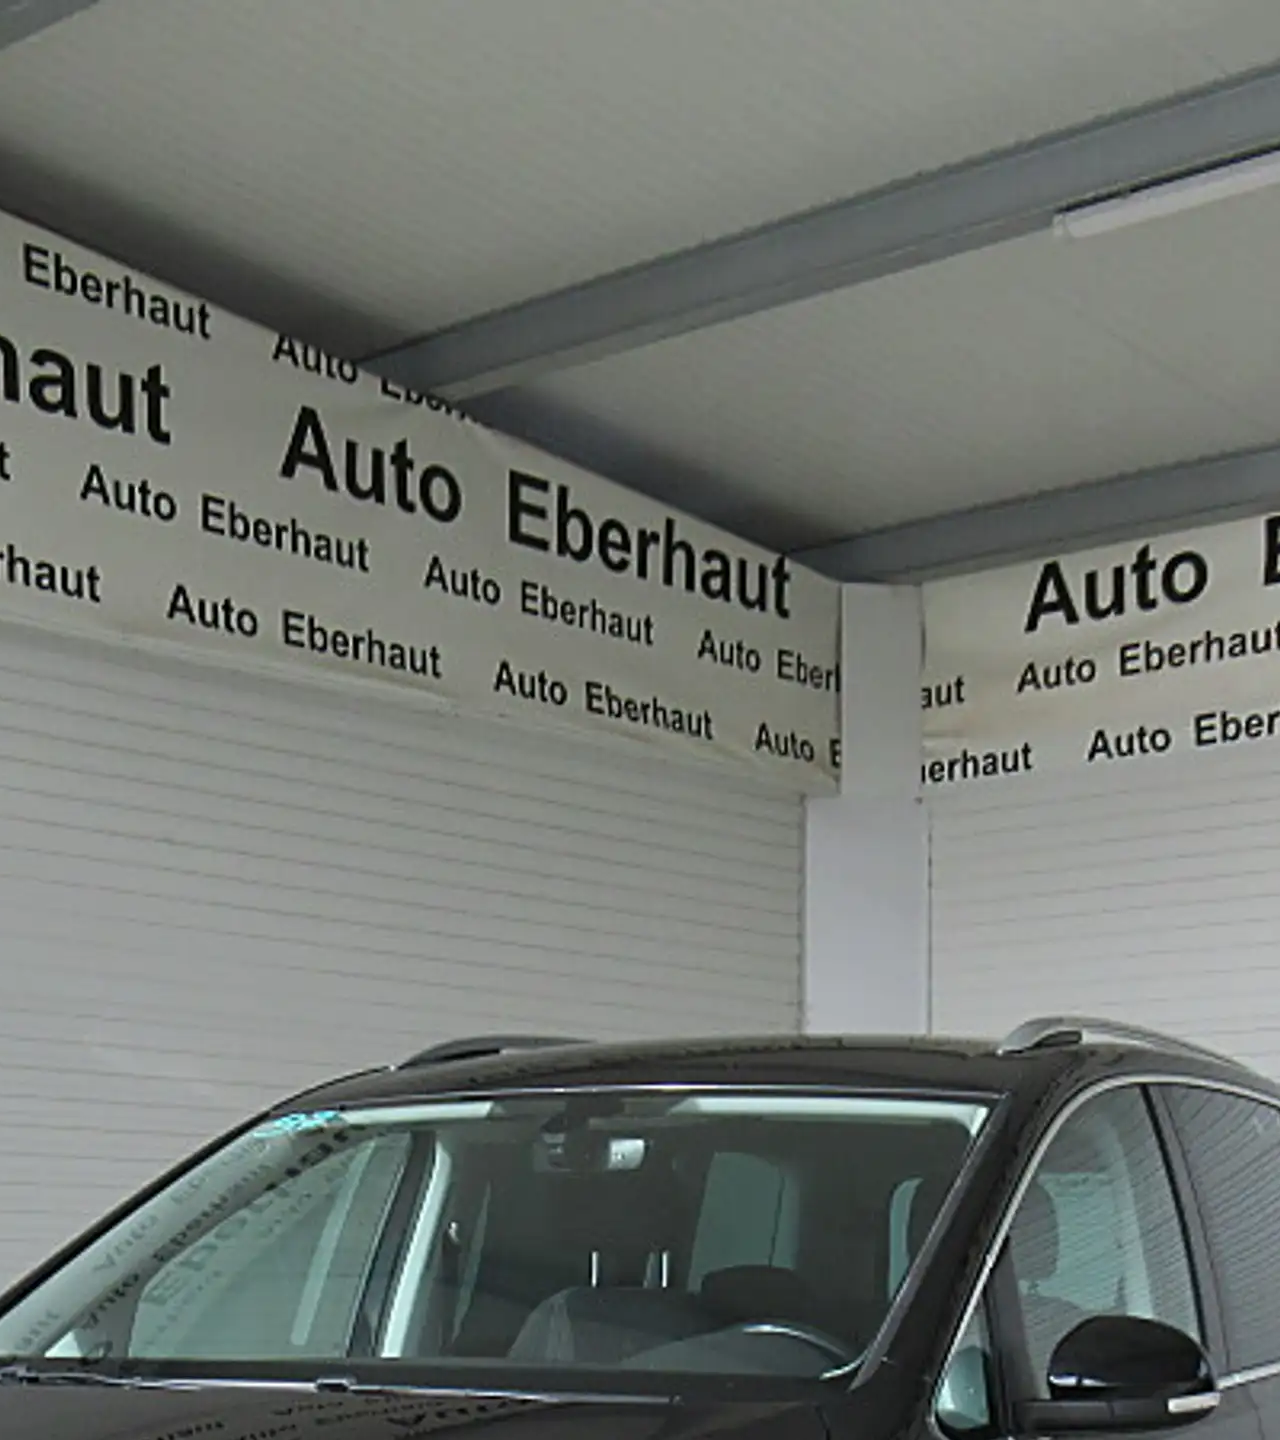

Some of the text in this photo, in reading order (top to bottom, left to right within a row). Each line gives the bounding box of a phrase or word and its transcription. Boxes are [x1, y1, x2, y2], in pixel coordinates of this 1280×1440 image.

[22, 242, 211, 341] Eberhaut
[79, 463, 370, 573] Auto Eberhaut
[279, 404, 792, 618] Auto Eberhaut
[166, 583, 442, 680] Auto Eberhaut
[423, 554, 654, 647] Auto Eberhaut
[1023, 543, 1209, 634] Auto
[697, 628, 762, 673] Auto
[1016, 655, 1097, 694] Auto
[493, 659, 713, 741] Auto Eberhaut
[754, 721, 815, 763] Auto
[1087, 725, 1172, 763] Auto
